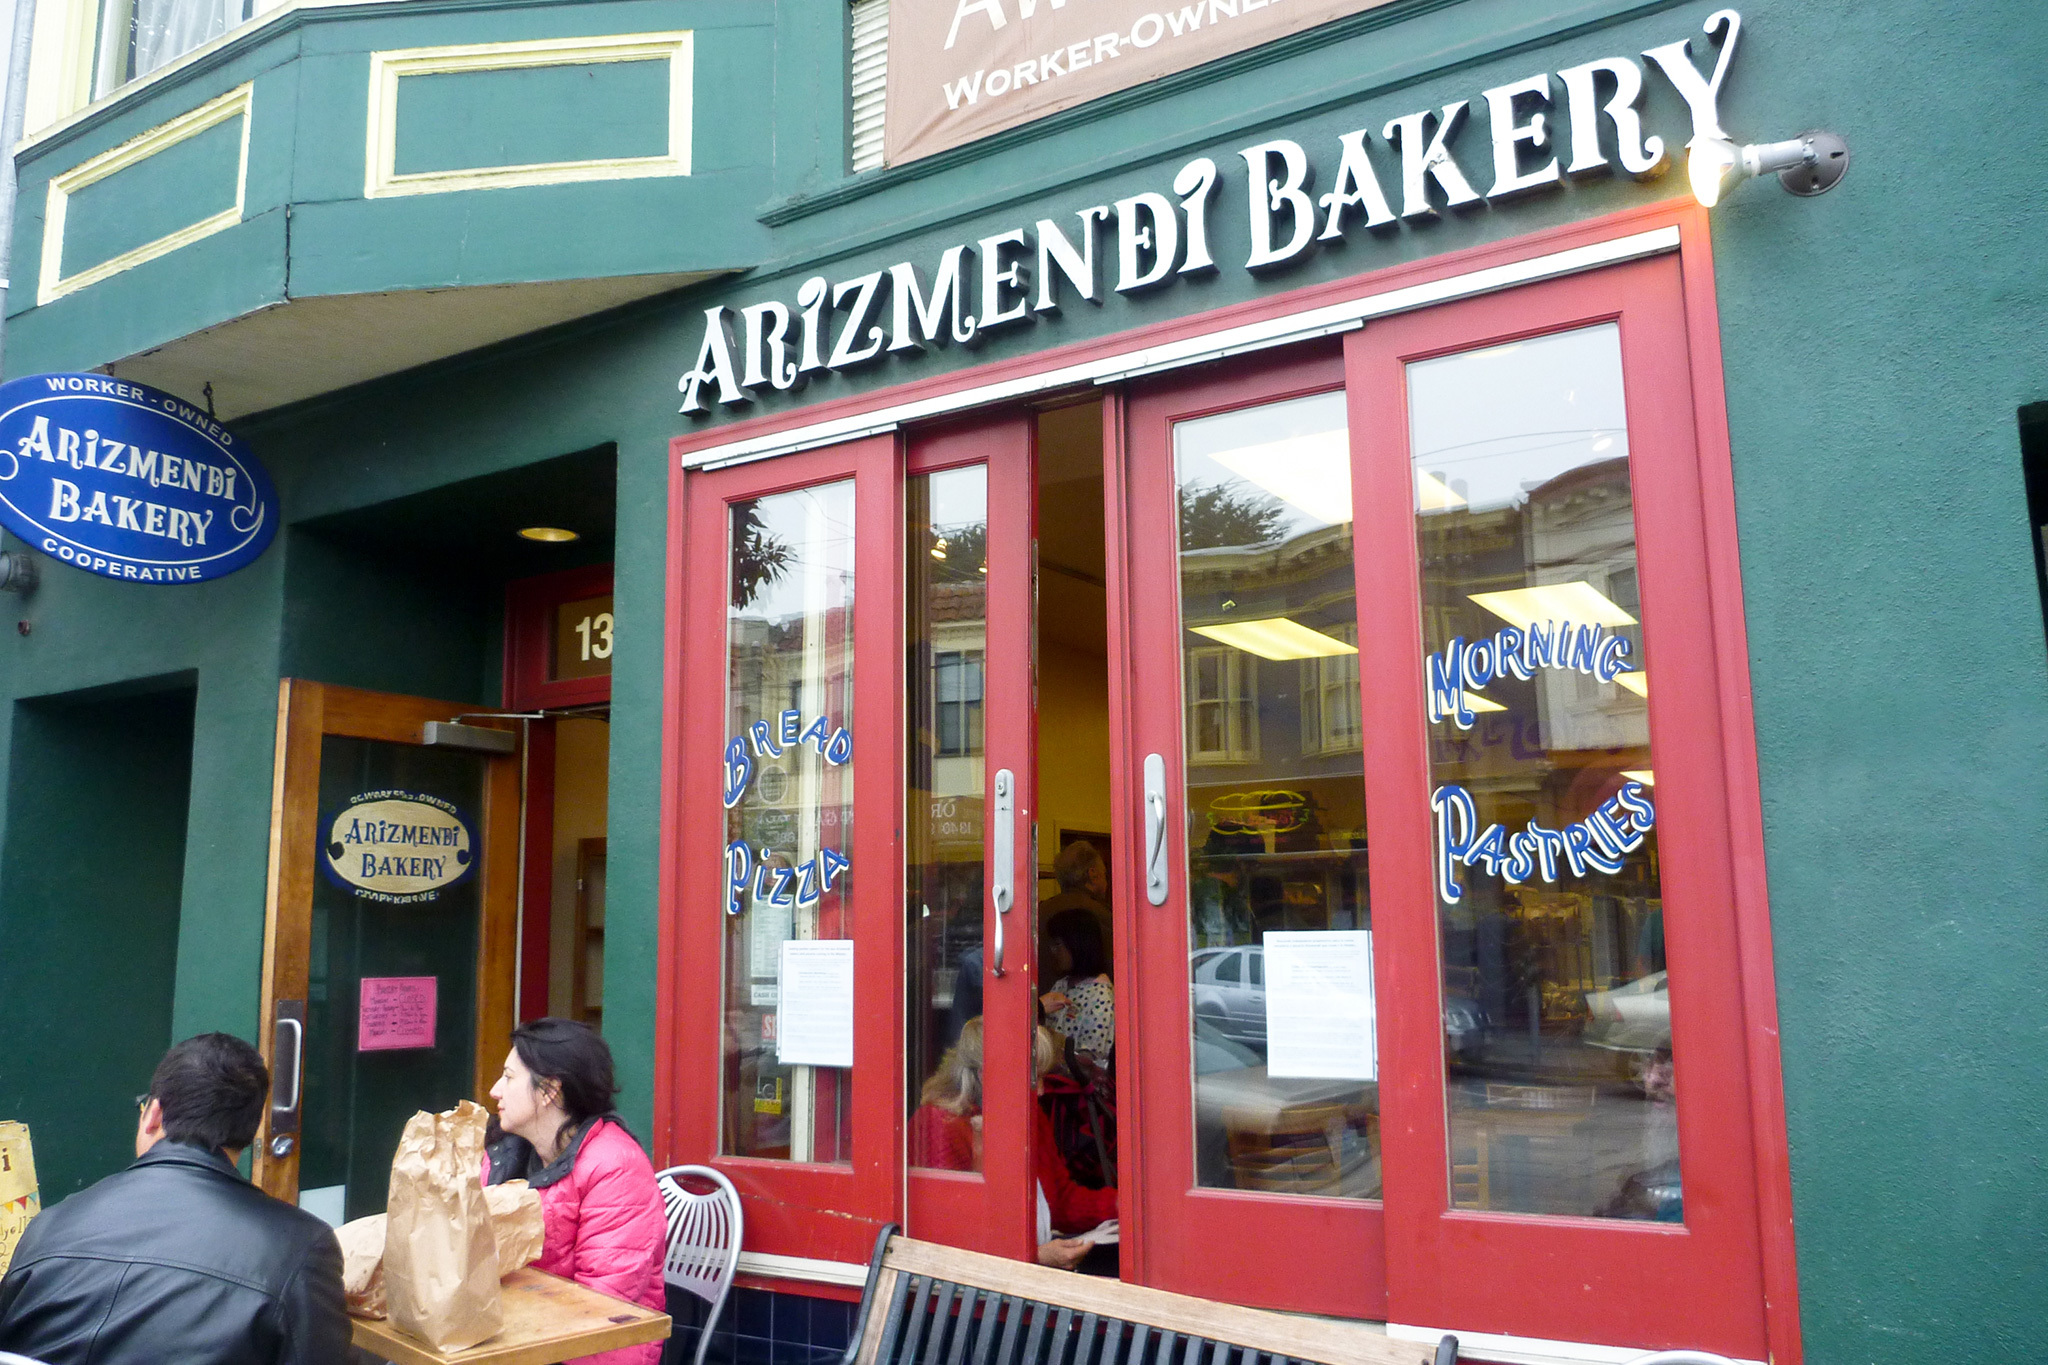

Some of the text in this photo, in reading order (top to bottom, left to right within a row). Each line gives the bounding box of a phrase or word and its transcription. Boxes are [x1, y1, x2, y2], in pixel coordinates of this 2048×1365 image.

[942, 0, 1280, 110] WORKER-OWN
[1237, 8, 1742, 269] BAKERY
[163, 398, 233, 446] OWNED
[43, 537, 202, 581] COOPERATIVE
[49, 477, 214, 547] BAKERY
[1426, 618, 1636, 731] MORNING
[723, 709, 852, 809] BREAD
[360, 853, 447, 881] BAKERY
[1430, 780, 1655, 904] PASTRIES
